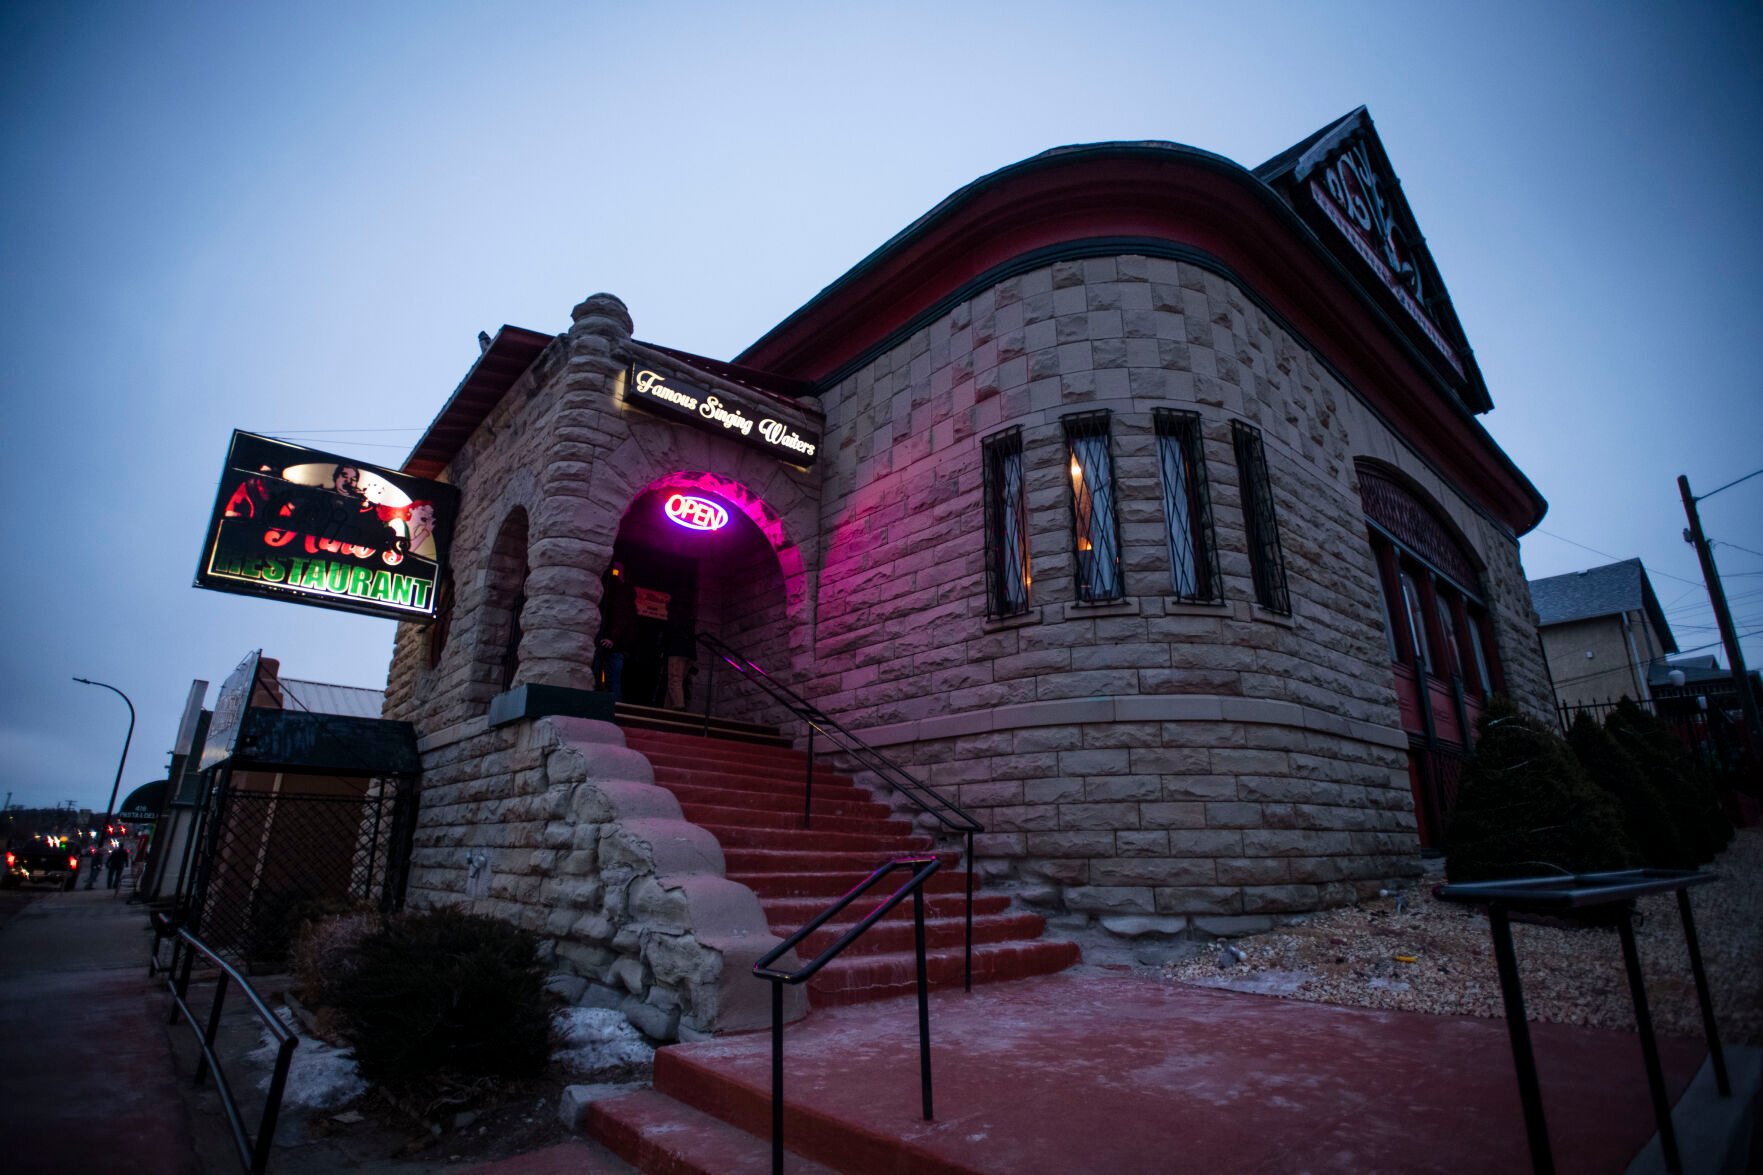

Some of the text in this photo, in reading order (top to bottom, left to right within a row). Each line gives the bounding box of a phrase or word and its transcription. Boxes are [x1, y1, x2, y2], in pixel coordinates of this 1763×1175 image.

[635, 370, 816, 456] Famous Singing Waiters
[665, 493, 723, 531] OPEN
[215, 551, 433, 609] RESTAURANT
